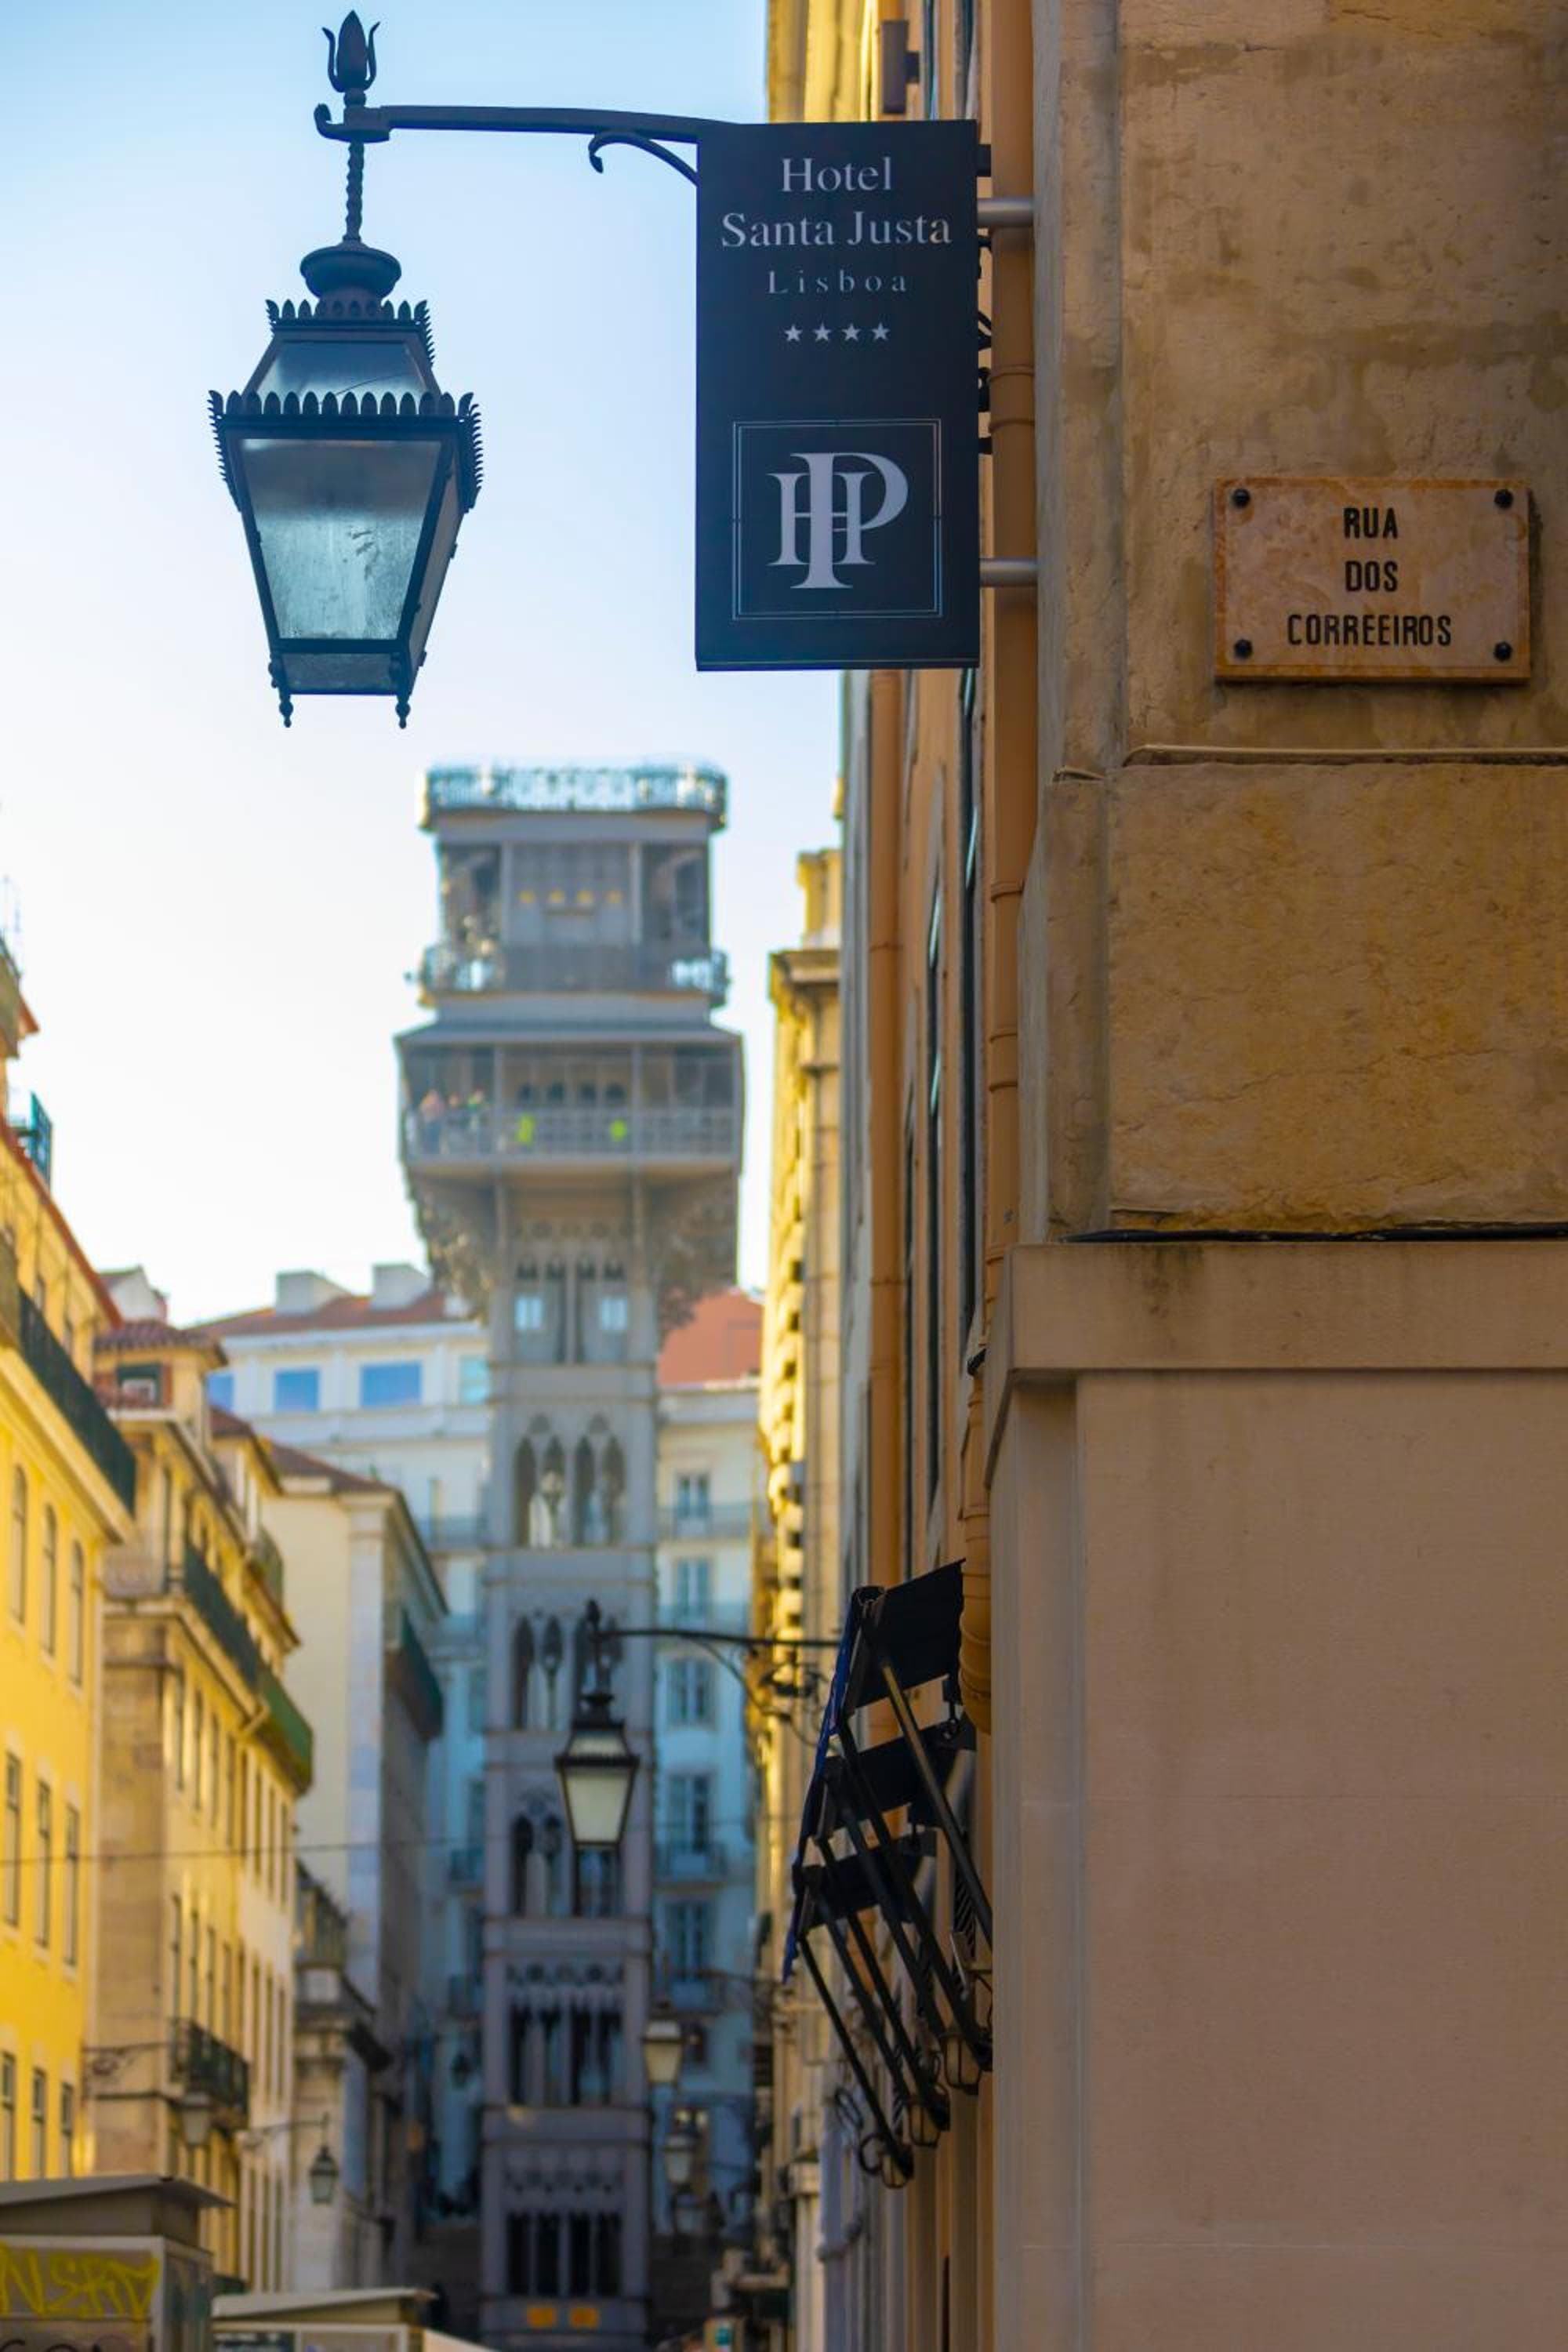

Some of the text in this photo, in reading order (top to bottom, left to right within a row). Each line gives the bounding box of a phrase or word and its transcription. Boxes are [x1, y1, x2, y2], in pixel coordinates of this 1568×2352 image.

[782, 156, 891, 192] Hotel
[721, 210, 953, 248] Santa Justa
[768, 269, 907, 294] Lisboa
[1344, 507, 1398, 539] RUA
[1345, 561, 1398, 593] DOS
[1287, 614, 1452, 647] CORREEIROS
